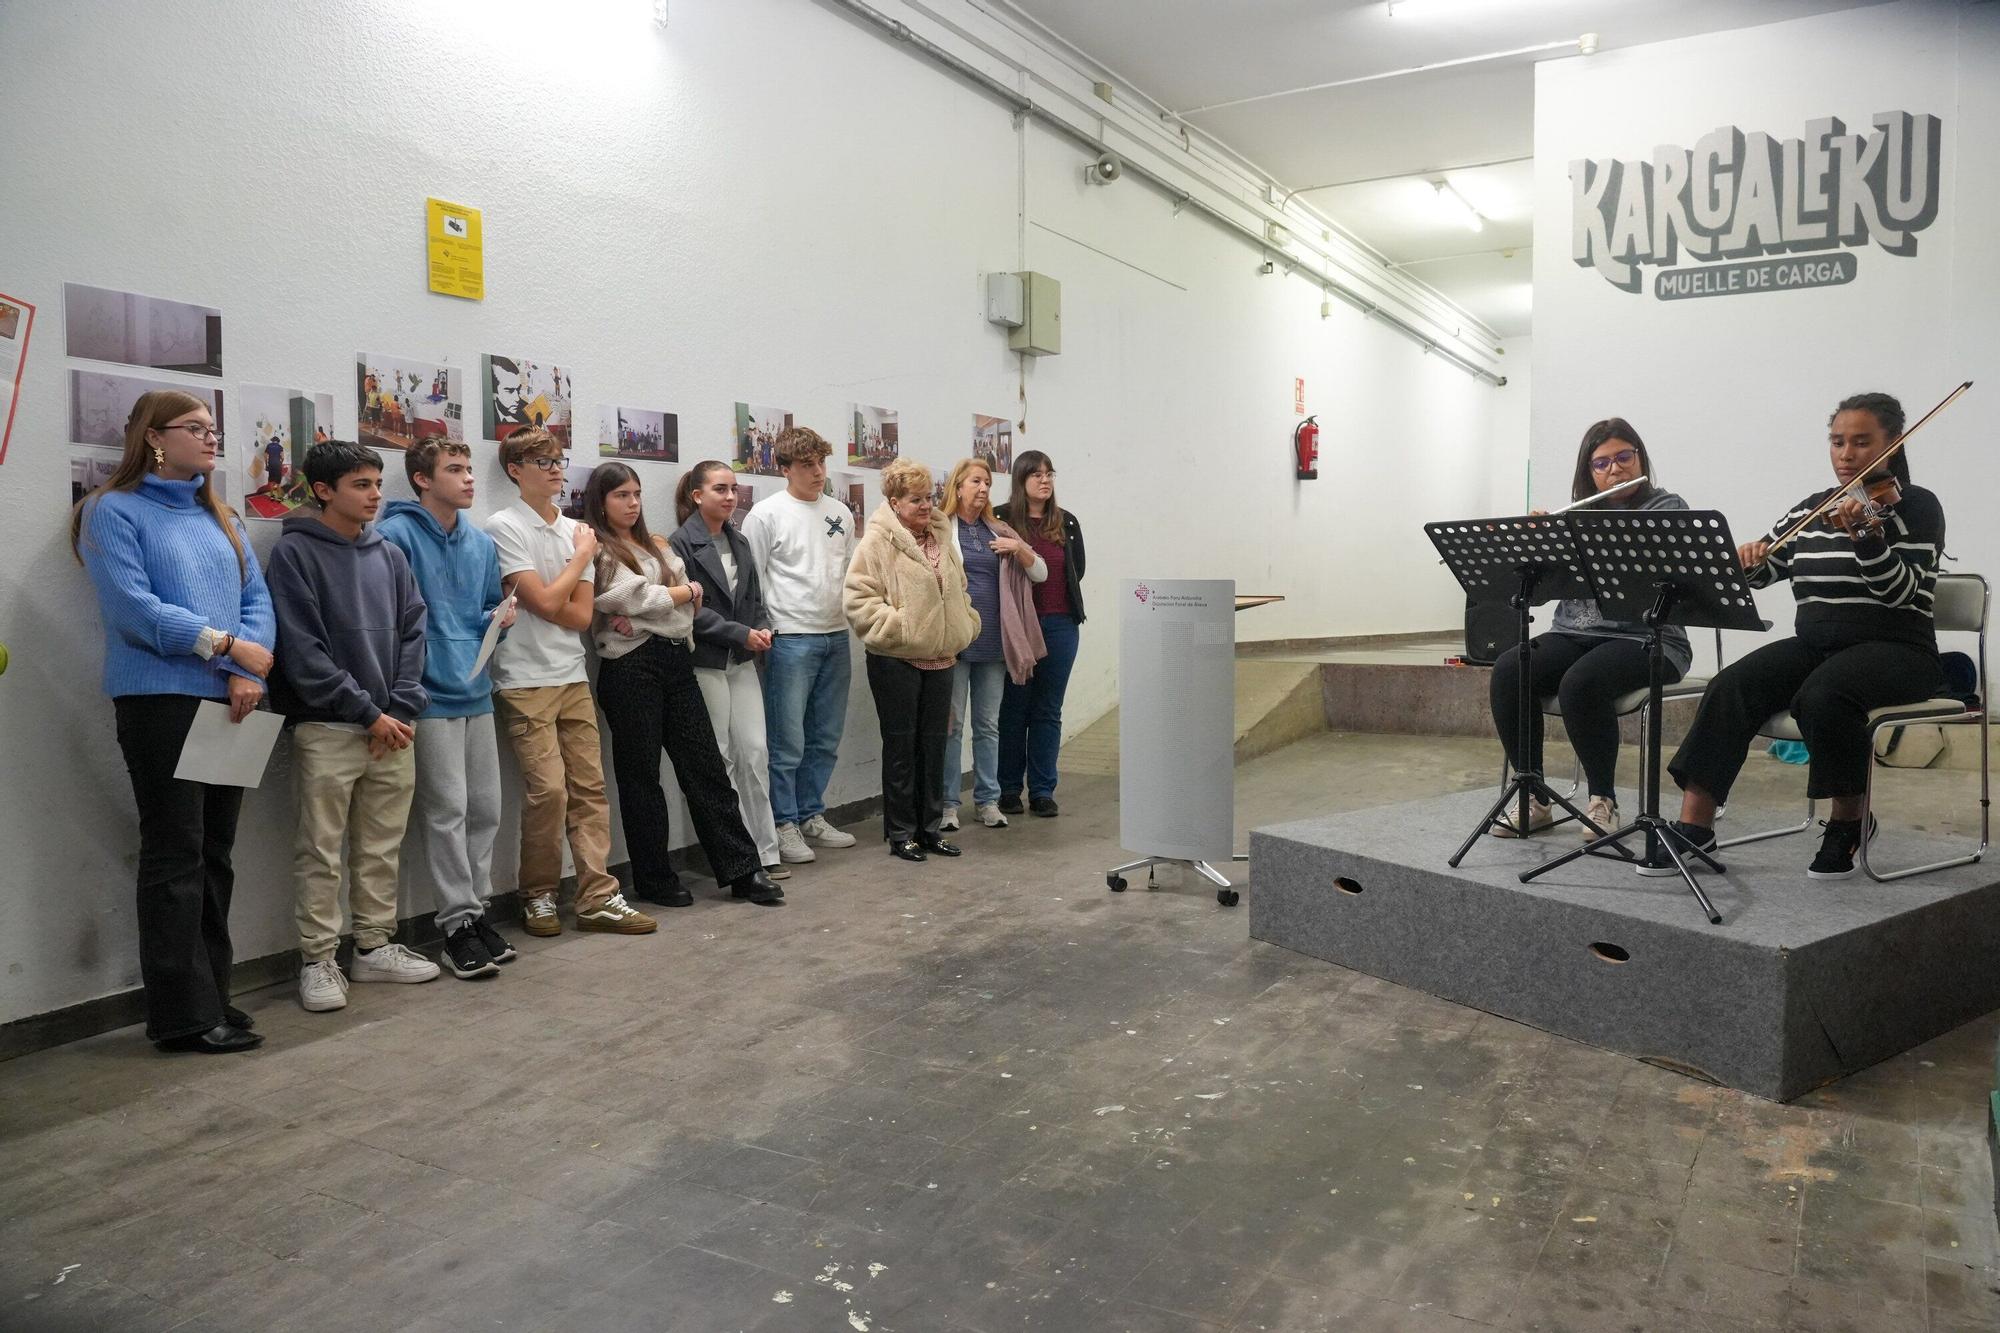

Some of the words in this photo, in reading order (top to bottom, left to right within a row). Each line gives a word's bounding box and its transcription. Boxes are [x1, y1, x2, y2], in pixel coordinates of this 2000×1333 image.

[1568, 110, 1942, 294] KARGALEKU
[1660, 270, 1741, 296] MUELLE
[1746, 267, 1771, 288] DE
[1775, 261, 1845, 286] CARGA
